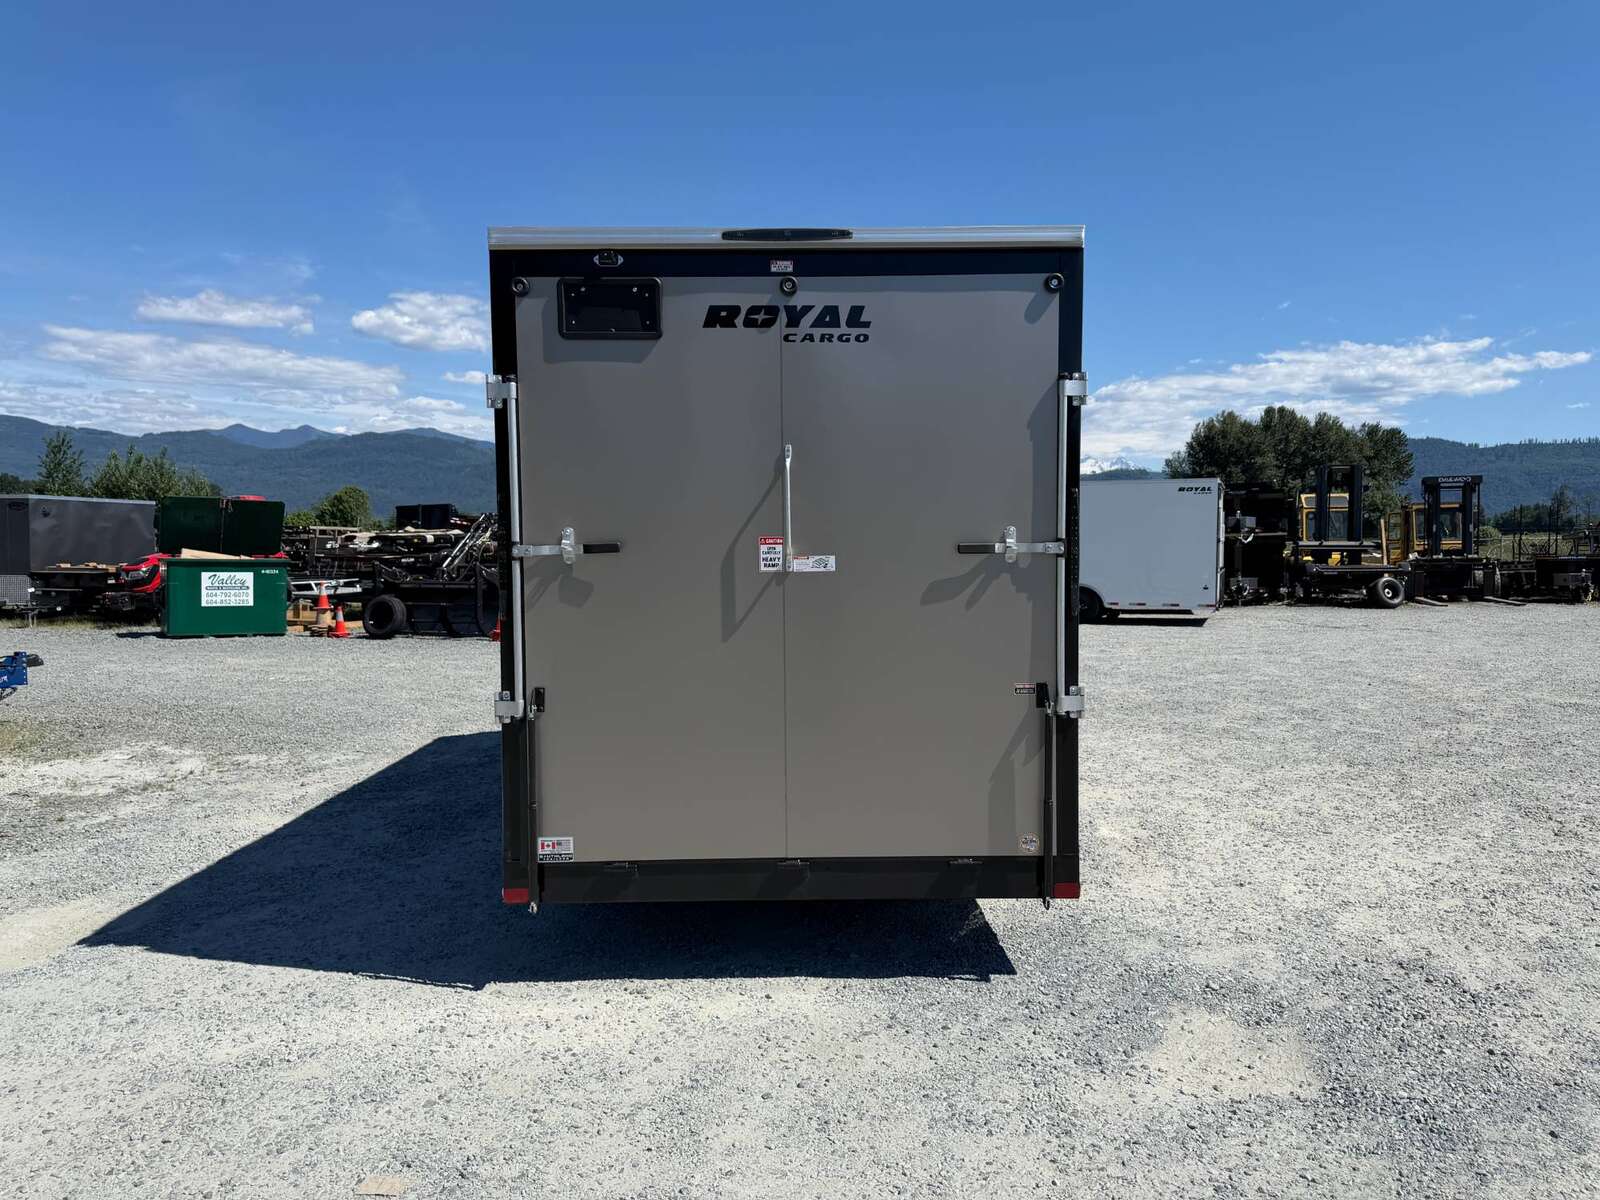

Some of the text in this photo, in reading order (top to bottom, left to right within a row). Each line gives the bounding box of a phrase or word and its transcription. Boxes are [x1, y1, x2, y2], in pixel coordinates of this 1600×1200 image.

[702, 305, 872, 328] ROYAL
[782, 333, 870, 343] CARGO
[208, 574, 247, 586] Valley
